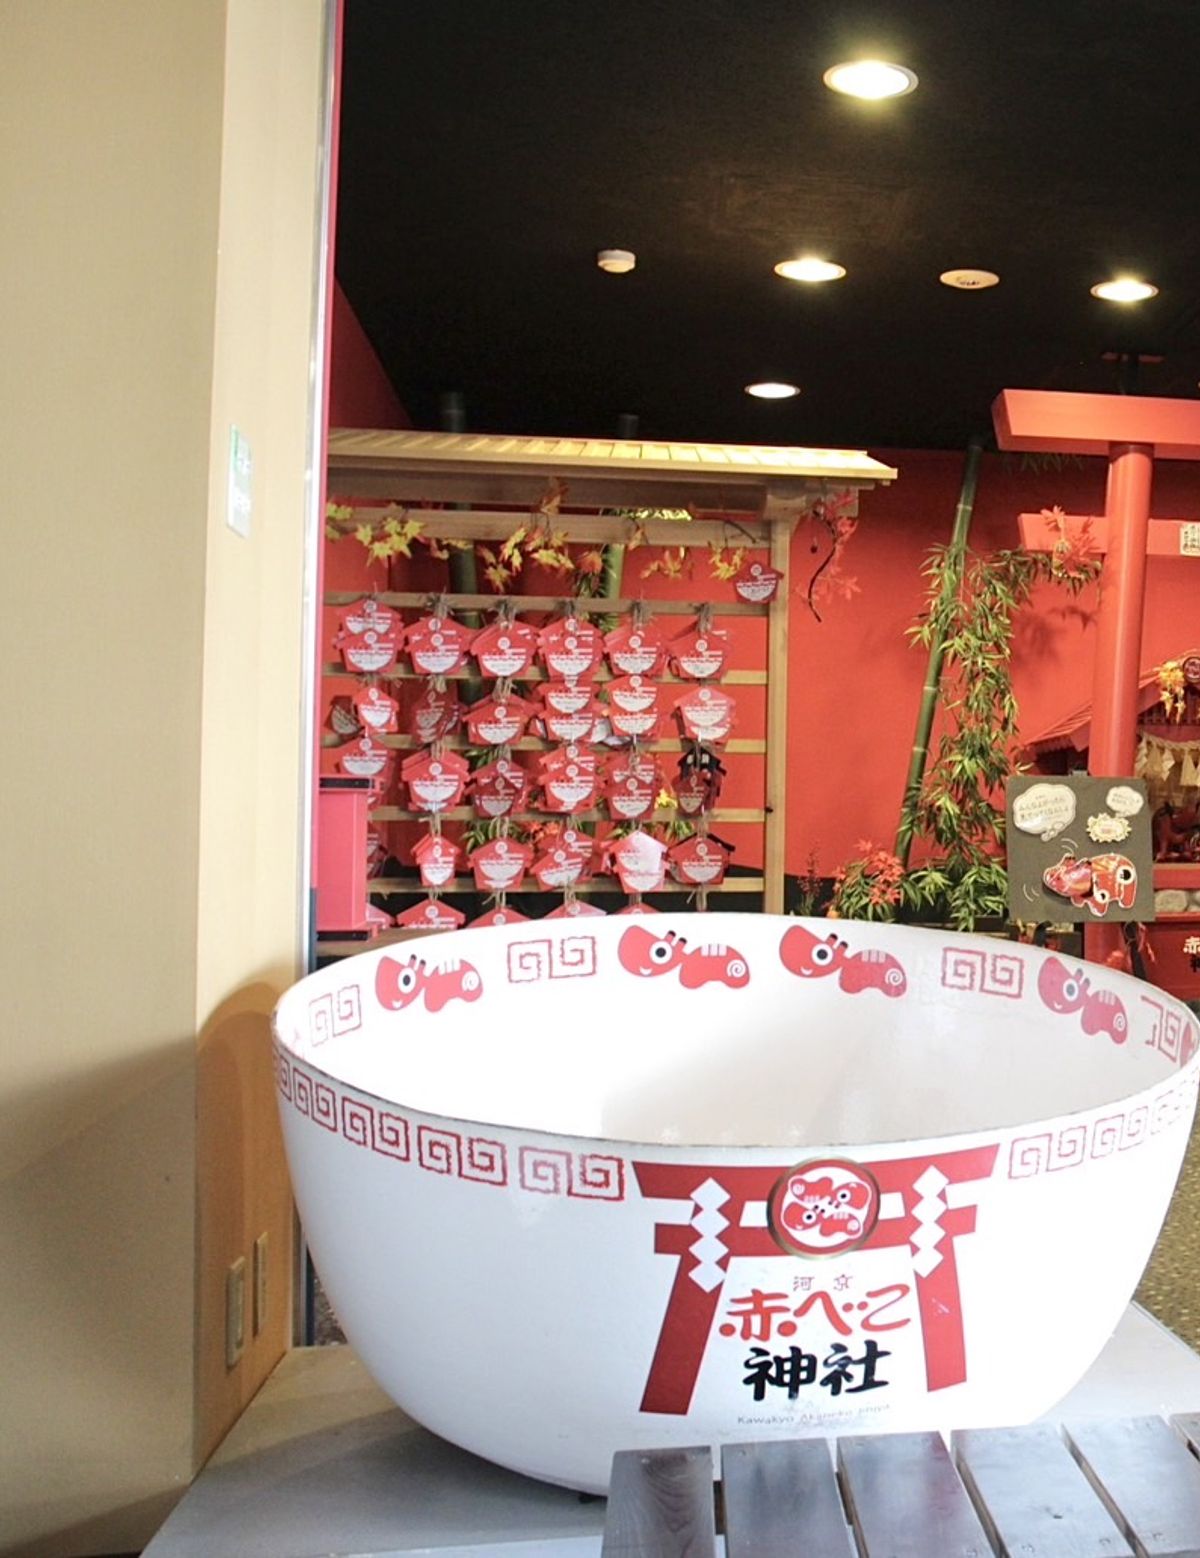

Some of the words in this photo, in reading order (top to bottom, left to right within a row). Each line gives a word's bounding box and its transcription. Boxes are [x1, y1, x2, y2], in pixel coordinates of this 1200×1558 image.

[792, 1273, 854, 1292] 河京
[718, 1283, 912, 1342] 赤べこ
[742, 1339, 892, 1401] 神社
